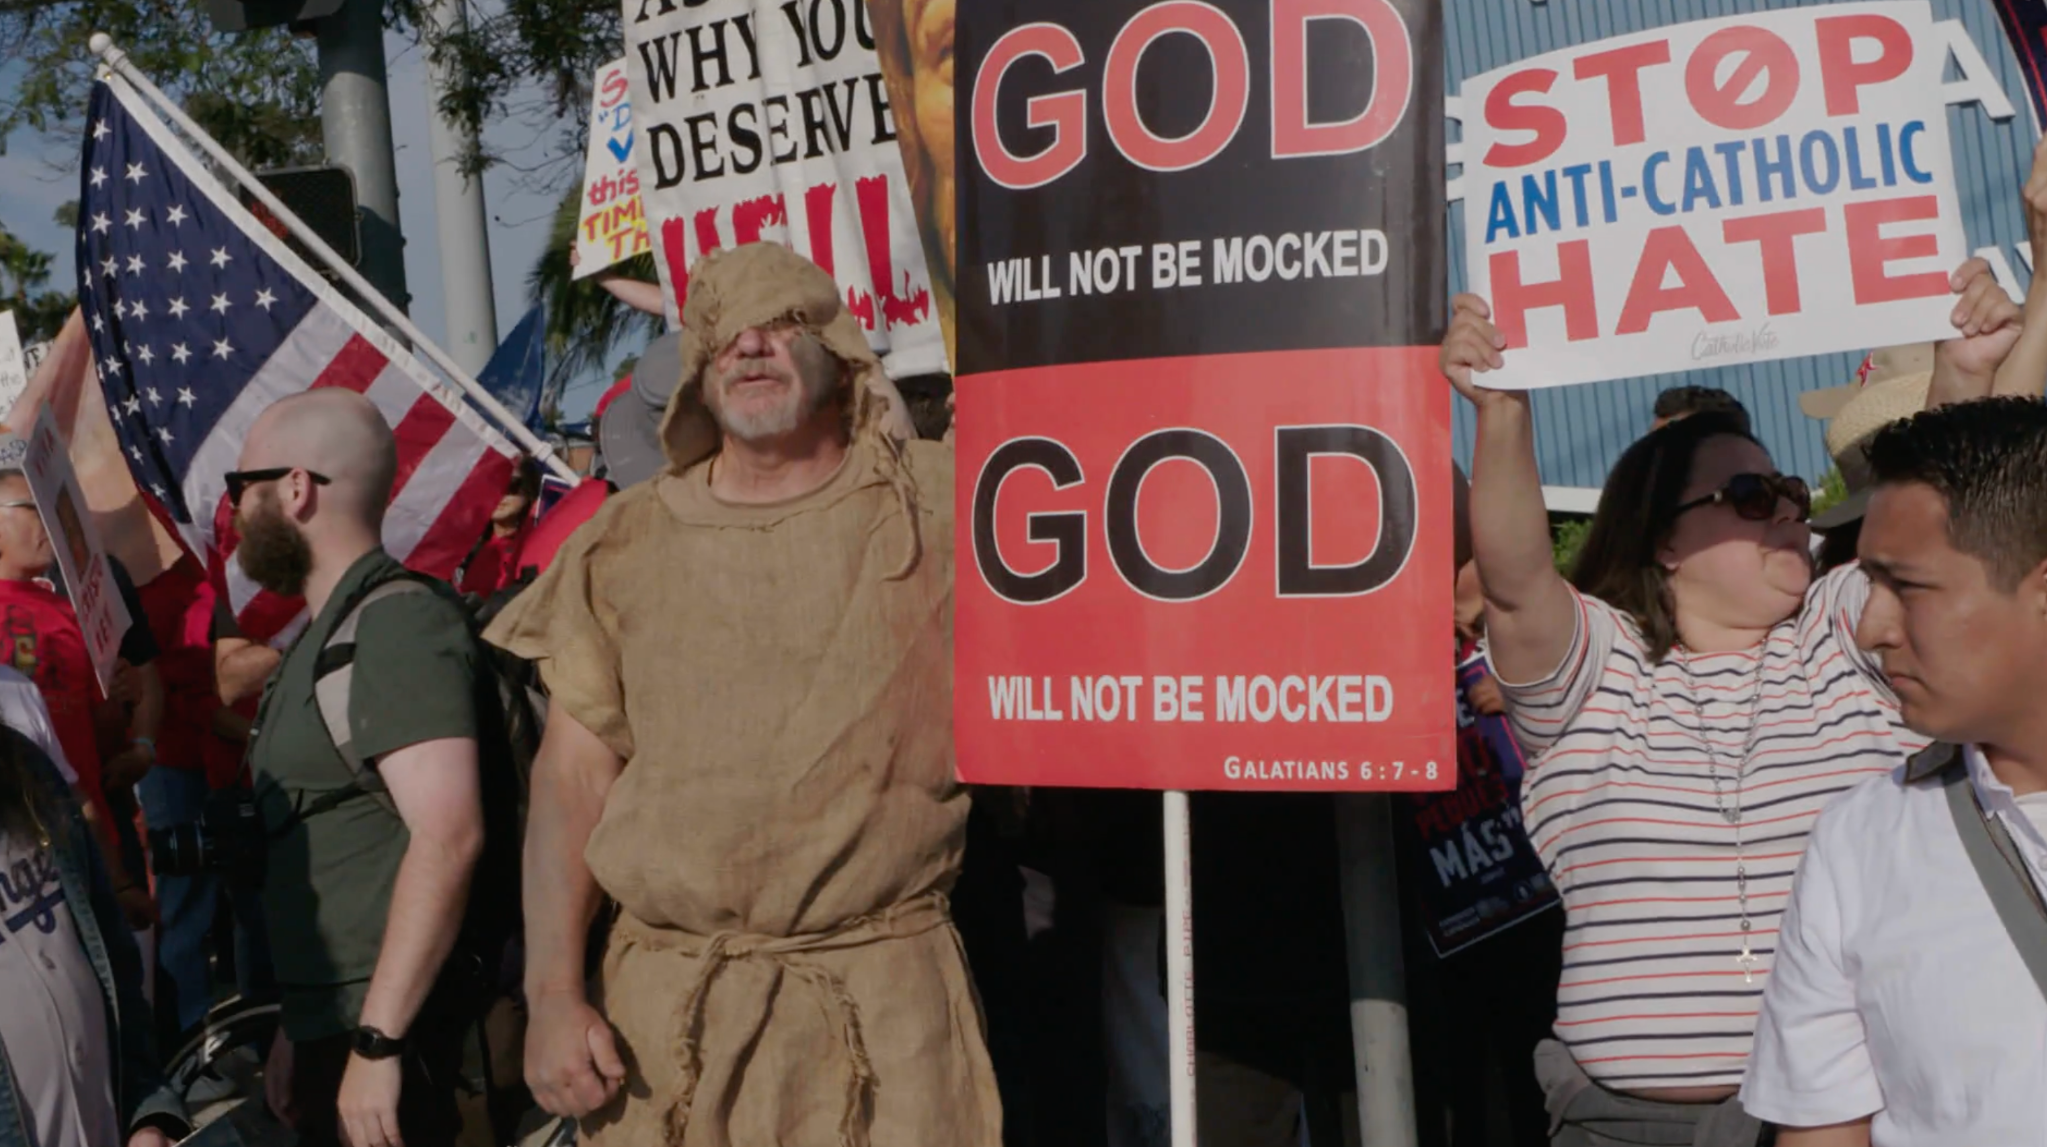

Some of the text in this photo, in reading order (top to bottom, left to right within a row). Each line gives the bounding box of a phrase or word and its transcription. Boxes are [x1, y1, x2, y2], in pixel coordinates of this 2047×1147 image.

[972, 0, 1413, 190] GOD
[1482, 13, 1914, 169] STOP
[587, 168, 641, 206] this
[1484, 119, 1933, 244] ANTI-CATHOLIC
[988, 229, 1389, 306] WILL NOT BE MOCKED
[1488, 194, 1952, 350] HATE
[972, 423, 1420, 606] GOD
[988, 675, 1394, 723] WILL NOT BE MOCKED
